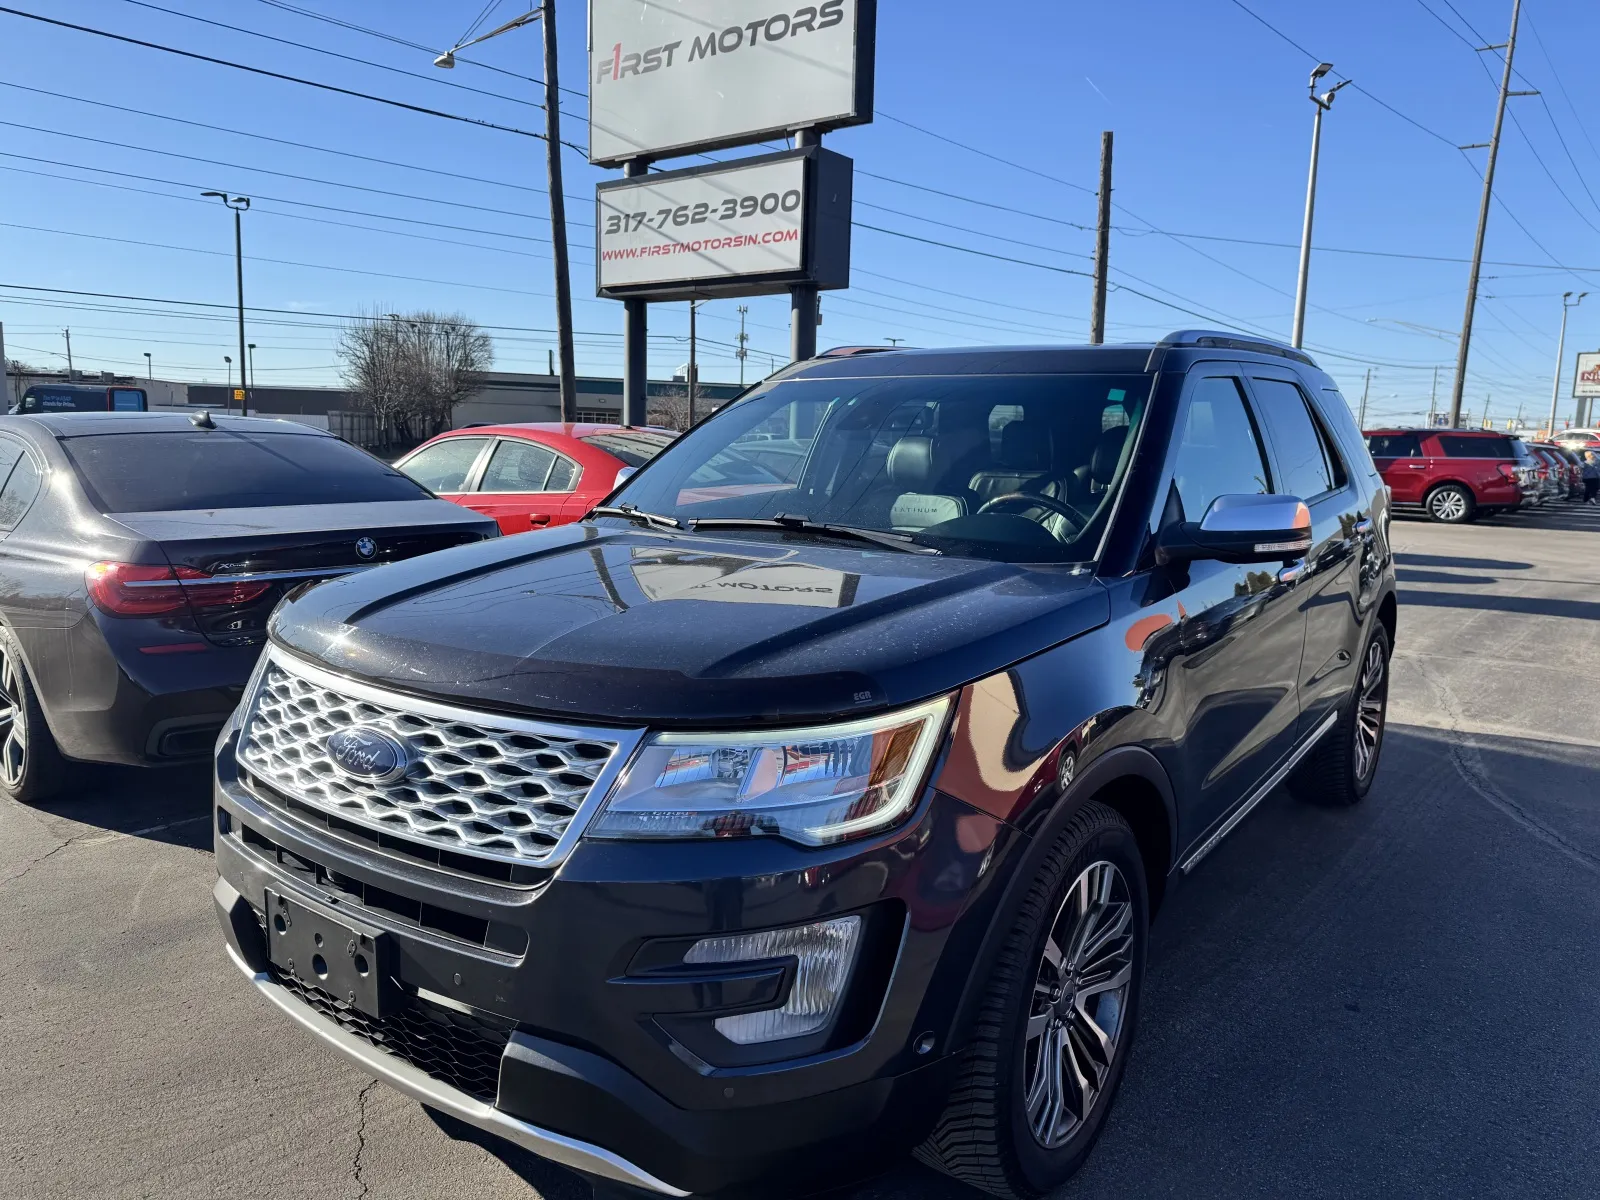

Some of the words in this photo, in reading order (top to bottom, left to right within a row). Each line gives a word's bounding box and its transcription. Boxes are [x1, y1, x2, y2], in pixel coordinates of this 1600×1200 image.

[688, 0, 844, 63] MOTORS
[605, 190, 801, 235] 317-762-3900
[602, 229, 798, 261] WWW.FIRSTMOTORSIN.COM
[853, 690, 872, 701] EGR
[336, 734, 380, 770] Ford
